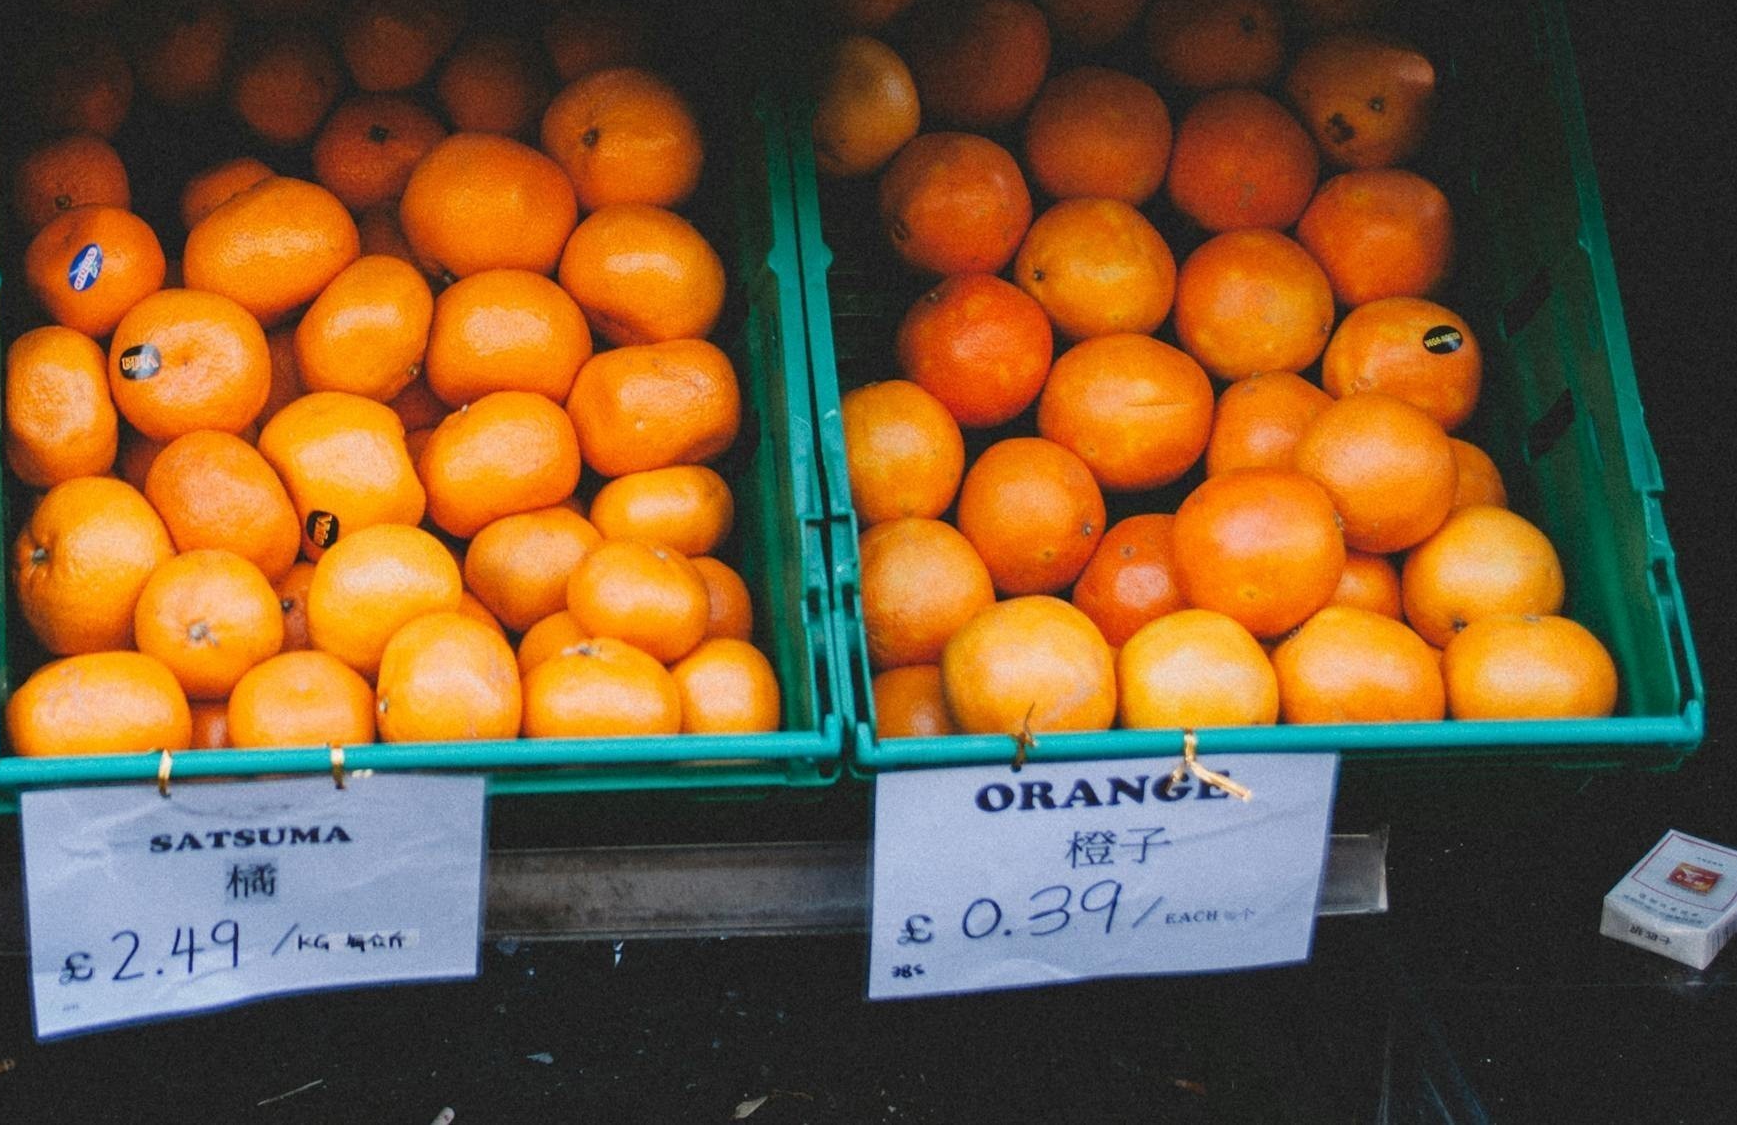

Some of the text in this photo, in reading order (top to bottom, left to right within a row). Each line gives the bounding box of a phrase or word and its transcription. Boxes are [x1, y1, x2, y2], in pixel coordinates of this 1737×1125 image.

[974, 770, 1231, 813] ORANGE
[150, 824, 353, 854] SATSUMA
[1064, 827, 1173, 870] 橙子
